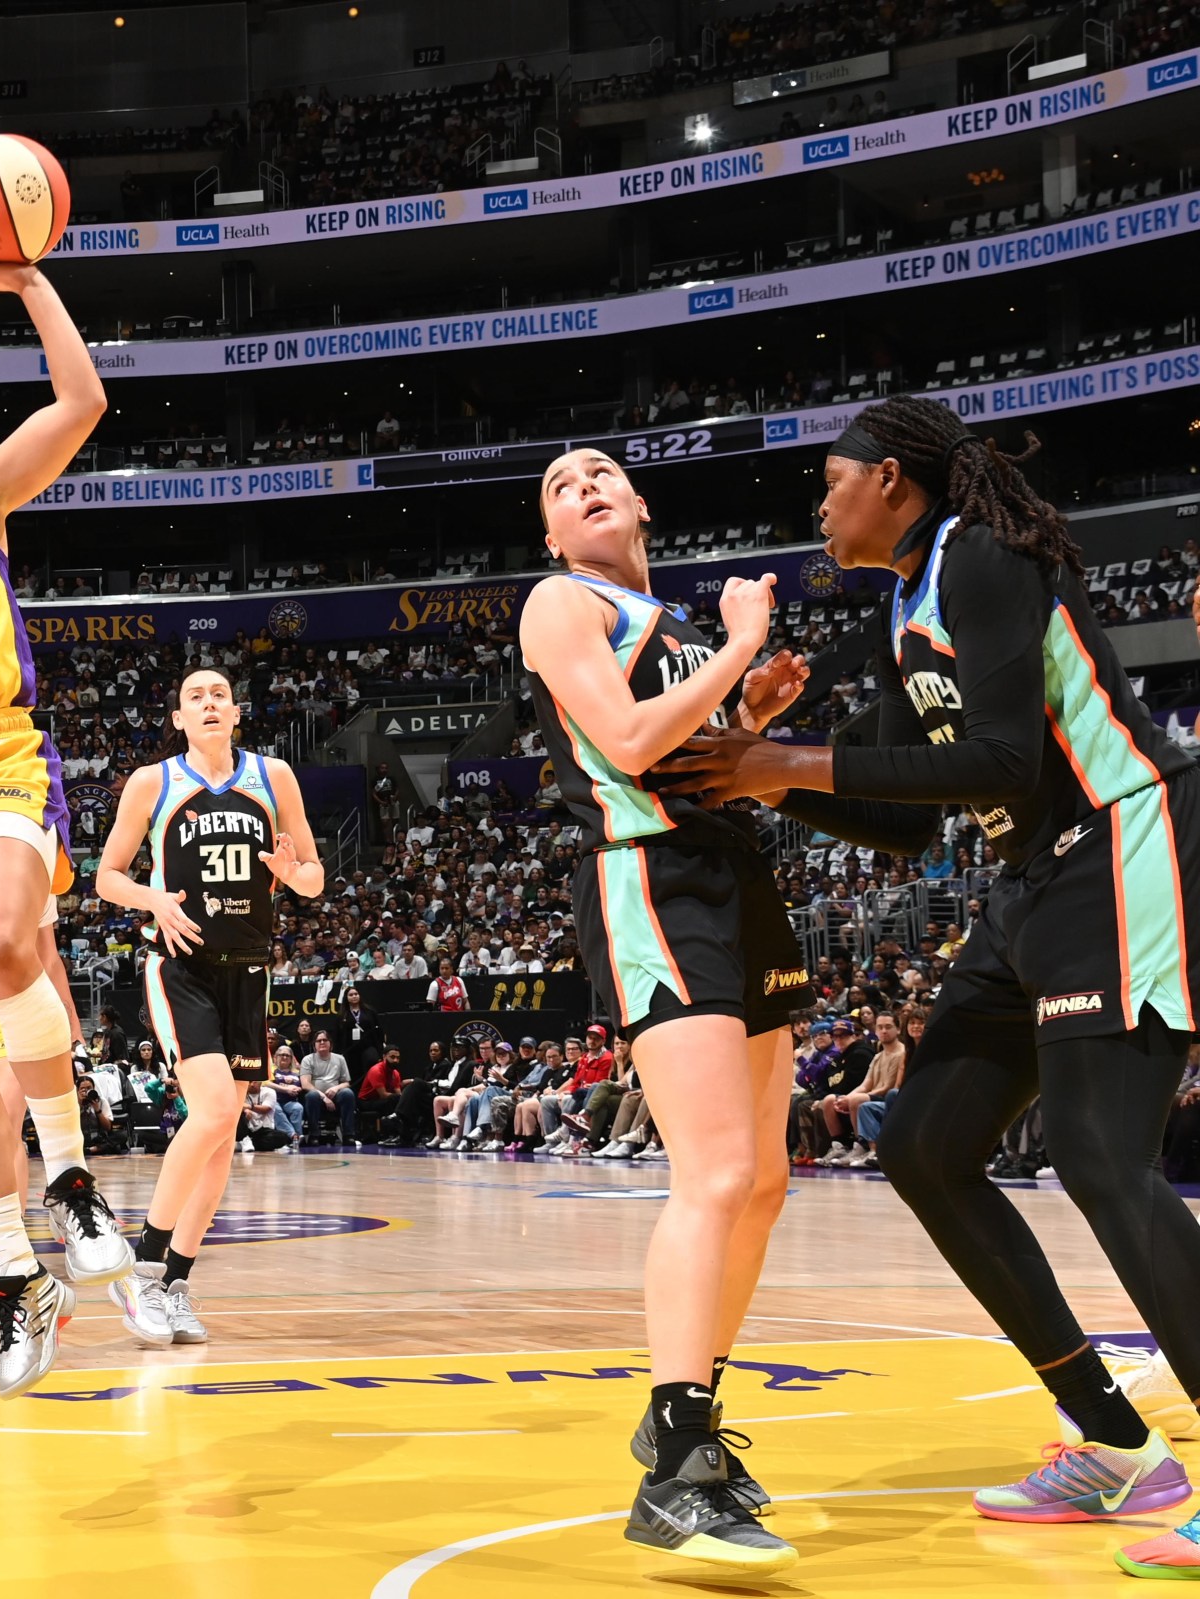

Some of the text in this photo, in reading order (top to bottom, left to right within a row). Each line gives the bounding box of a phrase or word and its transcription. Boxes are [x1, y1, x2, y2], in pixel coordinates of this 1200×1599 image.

[1154, 64, 1191, 83] UCLA
[948, 81, 1105, 137] KEEP ON RISING
[809, 130, 905, 158] UCLA Health
[620, 152, 763, 197] KEEP ON RISING
[489, 188, 581, 208] UCLA Health
[306, 199, 446, 234] KEEP ON RISING
[81, 229, 139, 250] RISING
[182, 224, 269, 241] UCLA Health
[886, 255, 935, 283] KEEP
[943, 249, 969, 274] ON
[978, 221, 1108, 268] OVERCOMING
[1117, 205, 1178, 239] EVERY
[694, 284, 788, 309] UCLA Health
[225, 309, 598, 365] KEEP ON OVERCOMING EVERY CHALLENGE
[958, 392, 985, 416] ON
[993, 374, 1094, 412] BELIEVING
[1102, 368, 1137, 393] IT'S
[766, 424, 791, 438] CLA
[625, 430, 712, 463] 5:22
[82, 481, 106, 502] ON
[113, 476, 204, 500] BELIEVING
[211, 475, 242, 496] IT'S
[249, 468, 333, 493] POSSIBLE
[429, 585, 518, 600] LOS ANGELES
[696, 580, 721, 593] 210
[389, 589, 515, 631] SPARKS
[26, 615, 154, 643] SPARKS
[189, 618, 217, 630] 209
[412, 713, 487, 732] DELTA
[457, 770, 490, 788] 108
[179, 811, 264, 847] LIBERTY
[1058, 825, 1082, 846] NIKE
[200, 844, 250, 882] 30
[223, 898, 251, 907] Liberty
[1046, 995, 1102, 1016] WNBA
